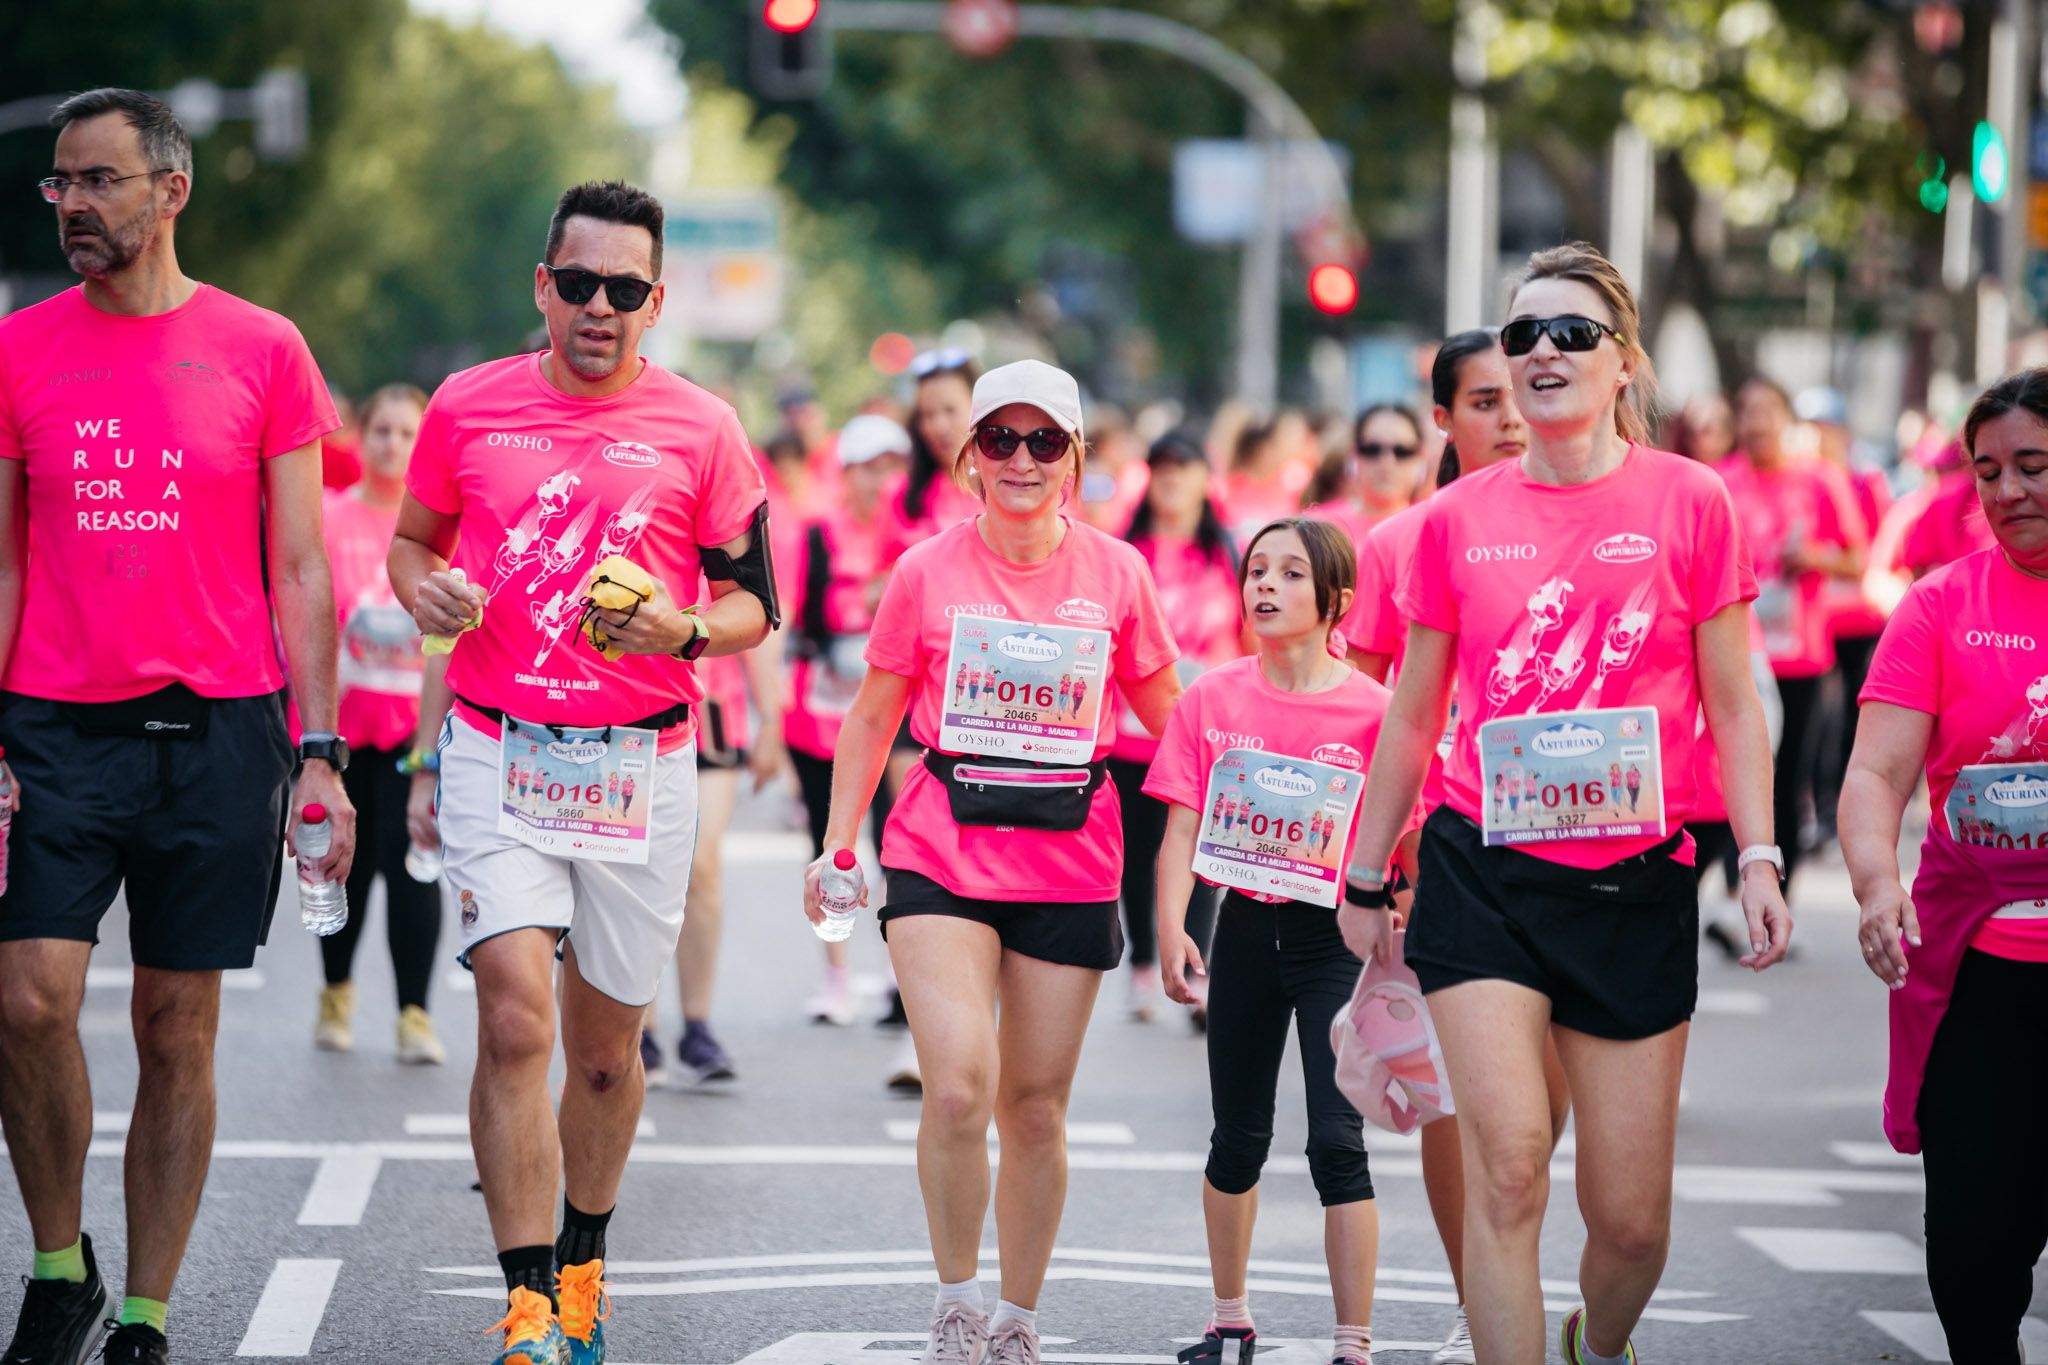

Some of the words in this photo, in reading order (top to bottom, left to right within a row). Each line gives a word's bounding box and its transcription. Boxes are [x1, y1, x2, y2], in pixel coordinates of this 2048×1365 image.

[75, 418, 122, 439] WE
[487, 431, 553, 452] OYSHO
[607, 447, 656, 464] ASTURIANA
[74, 479, 125, 501] FOR
[162, 480, 182, 501] A
[77, 510, 180, 532] REASON
[1466, 543, 1537, 564] OYSHO
[1600, 544, 1653, 559] ASTURIANA
[944, 603, 1008, 618] OYSHO
[1001, 640, 1059, 658] ASTURIANA
[1965, 630, 2036, 651] OYSHO
[515, 672, 548, 687] CARRERA
[549, 678, 560, 688] DE
[561, 679, 571, 689] LA
[572, 679, 600, 691] MUJER
[547, 689, 567, 700] 2024
[997, 680, 1054, 708] 016
[1004, 709, 1038, 722] 20465
[961, 716, 994, 729] CARRERA
[996, 720, 1006, 730] DE
[1007, 721, 1017, 731] LA
[1019, 722, 1043, 734] MUJER
[1048, 727, 1079, 739] MADRID
[957, 732, 1005, 748] OYSHO
[1206, 728, 1264, 751] OYSHO
[1538, 737, 1600, 751] ASTURIANA
[1034, 743, 1079, 757] Santander
[1258, 771, 1313, 794] ASTURIANA
[546, 782, 604, 805] 016
[1541, 780, 1606, 809] 016
[1990, 787, 2048, 800] ASTURIAN
[556, 807, 584, 819] 5860
[1556, 813, 1587, 827] 5327
[544, 819, 555, 828] DE
[555, 820, 567, 829] LA
[567, 820, 594, 832] MUJER
[599, 824, 630, 837] MADRID
[1251, 813, 1304, 844] 016
[1505, 829, 1544, 842] CARRERA
[1545, 830, 1558, 840] DE
[1559, 828, 1570, 839] LA
[1571, 826, 1601, 838] MUJER
[1606, 823, 1643, 836] MADRID
[1256, 842, 1289, 857] 20462
[1208, 861, 1255, 880] OYSHO
[1214, 846, 1246, 860] CARRERA
[1247, 853, 1257, 862] DE
[1258, 855, 1268, 865] LA
[1268, 857, 1291, 869] MUJER
[1295, 862, 1325, 877] MADRID
[1281, 878, 1323, 896] Santander
